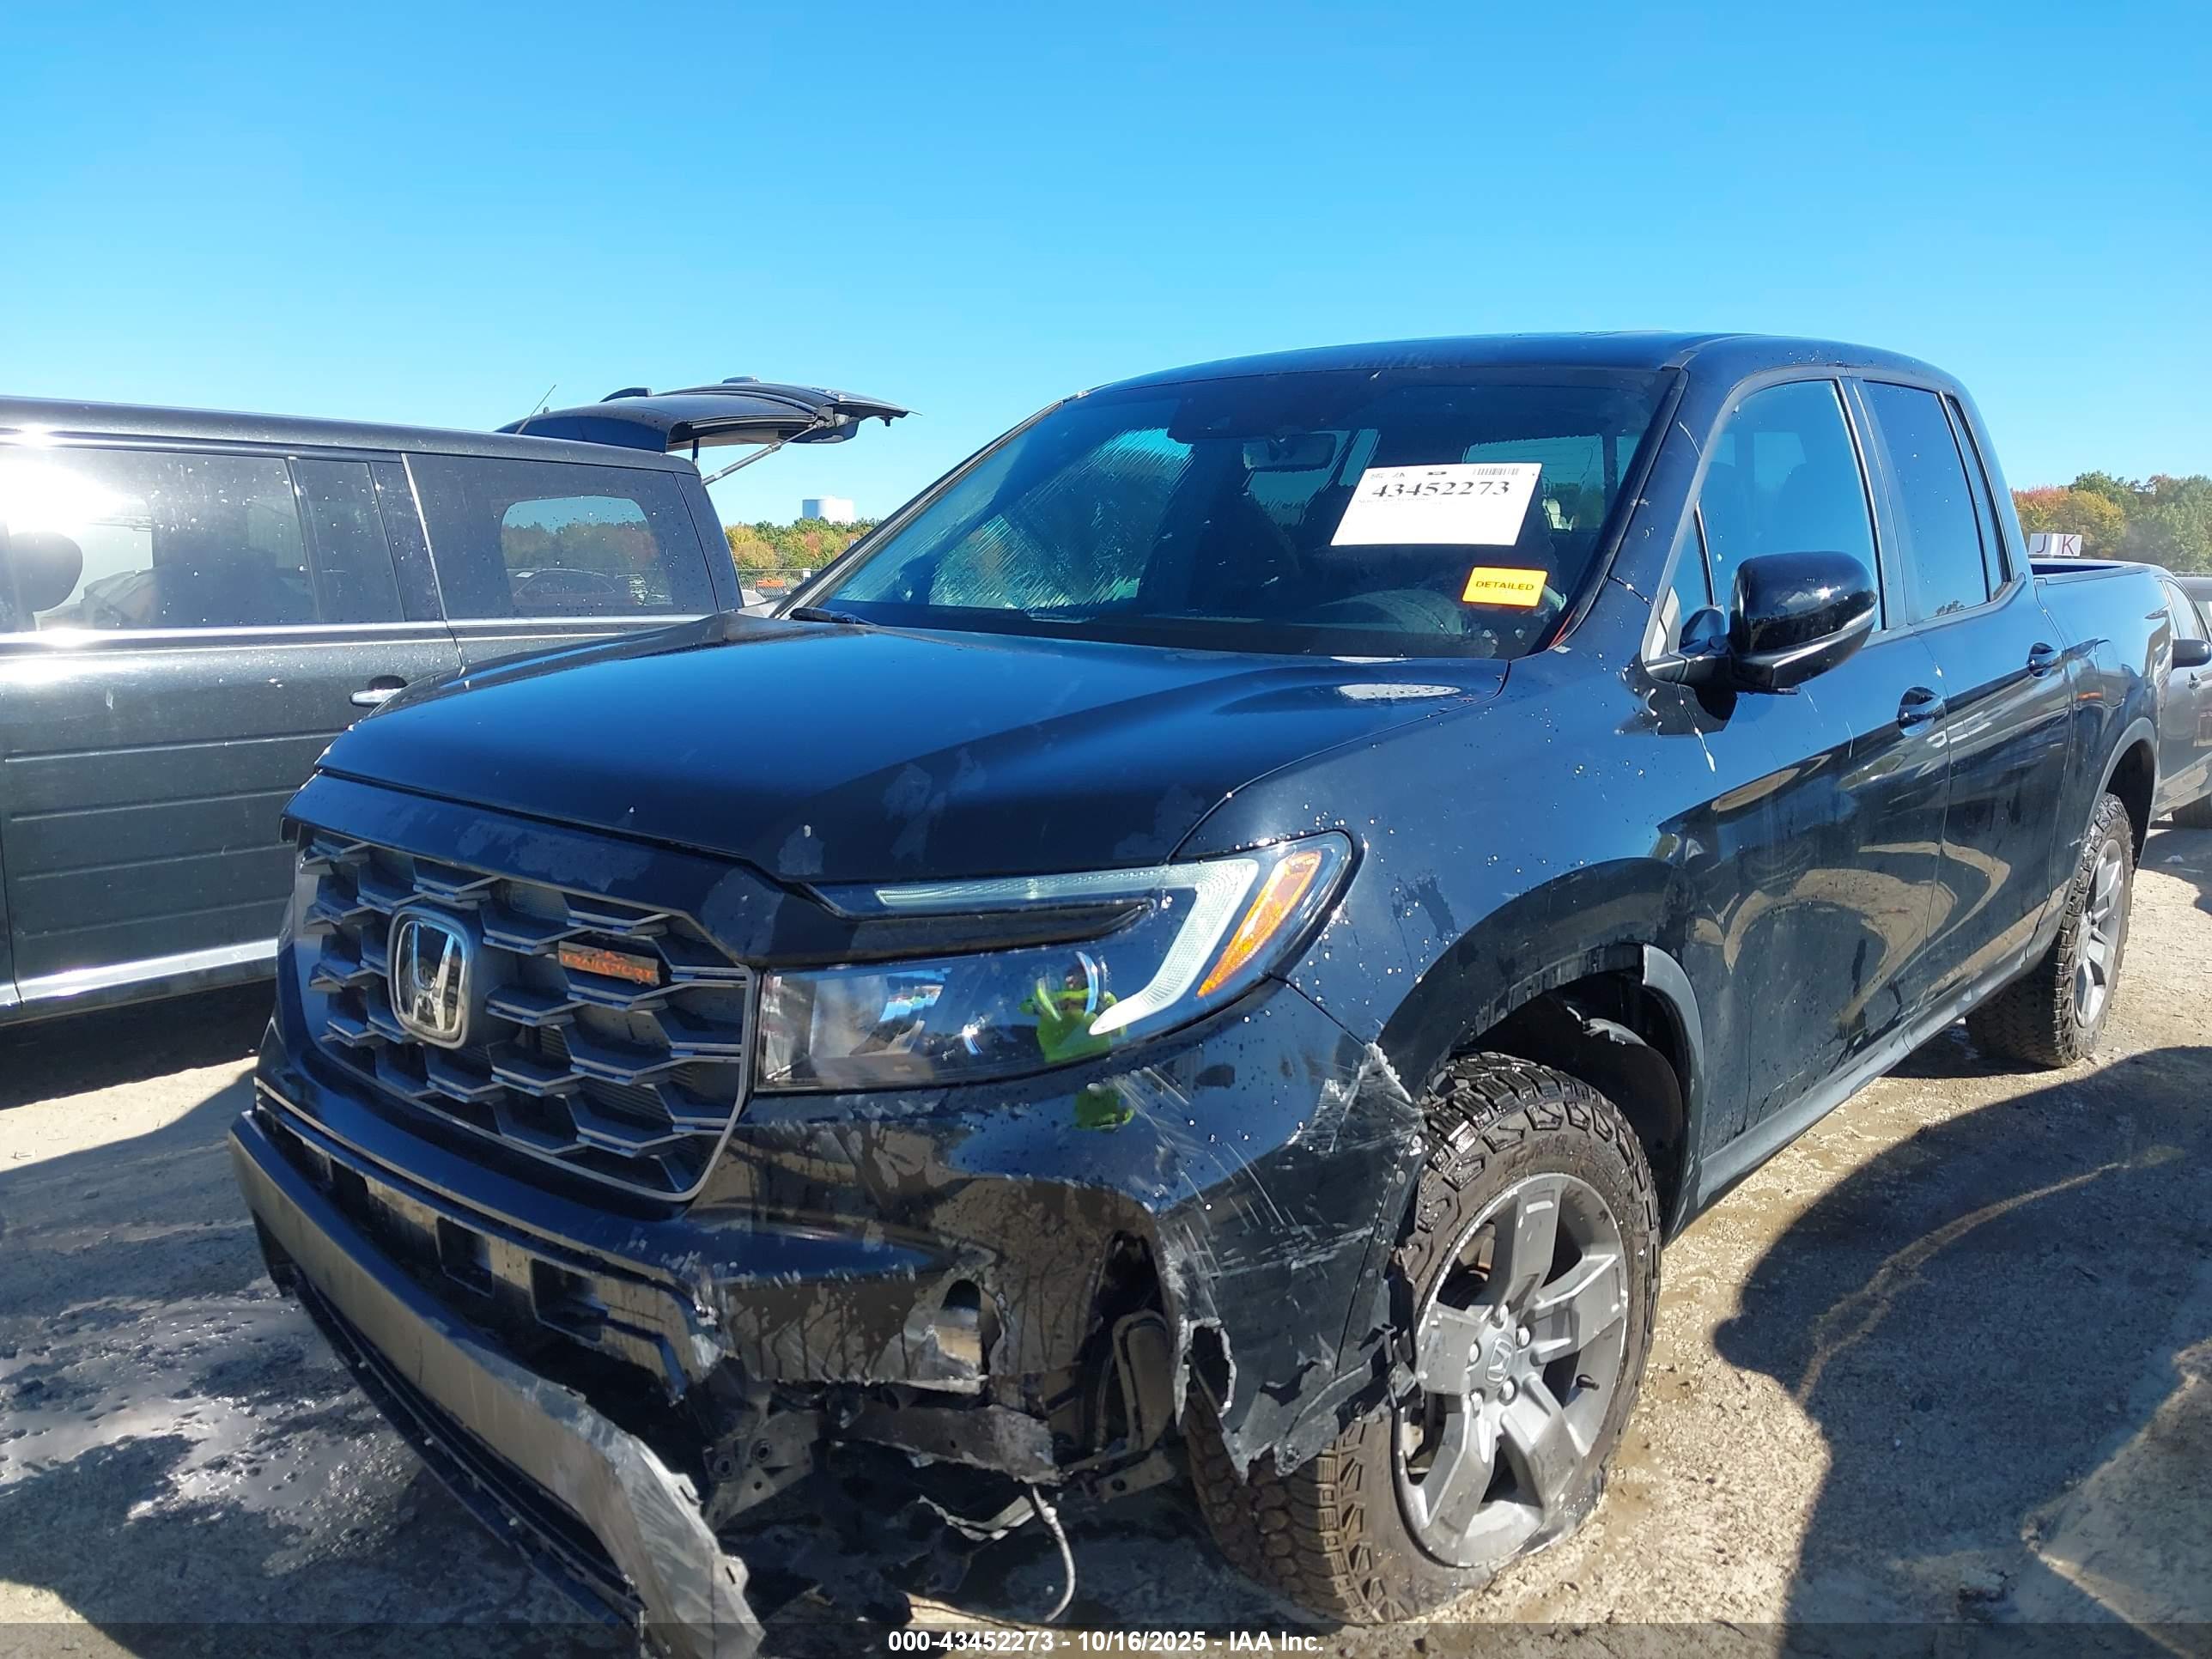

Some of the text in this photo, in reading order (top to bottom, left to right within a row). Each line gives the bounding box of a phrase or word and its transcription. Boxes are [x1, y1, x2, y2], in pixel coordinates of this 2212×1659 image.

[1371, 481, 1510, 497] 43452273
[2035, 534, 2076, 556] J K
[1475, 580, 1534, 591] DETAILED
